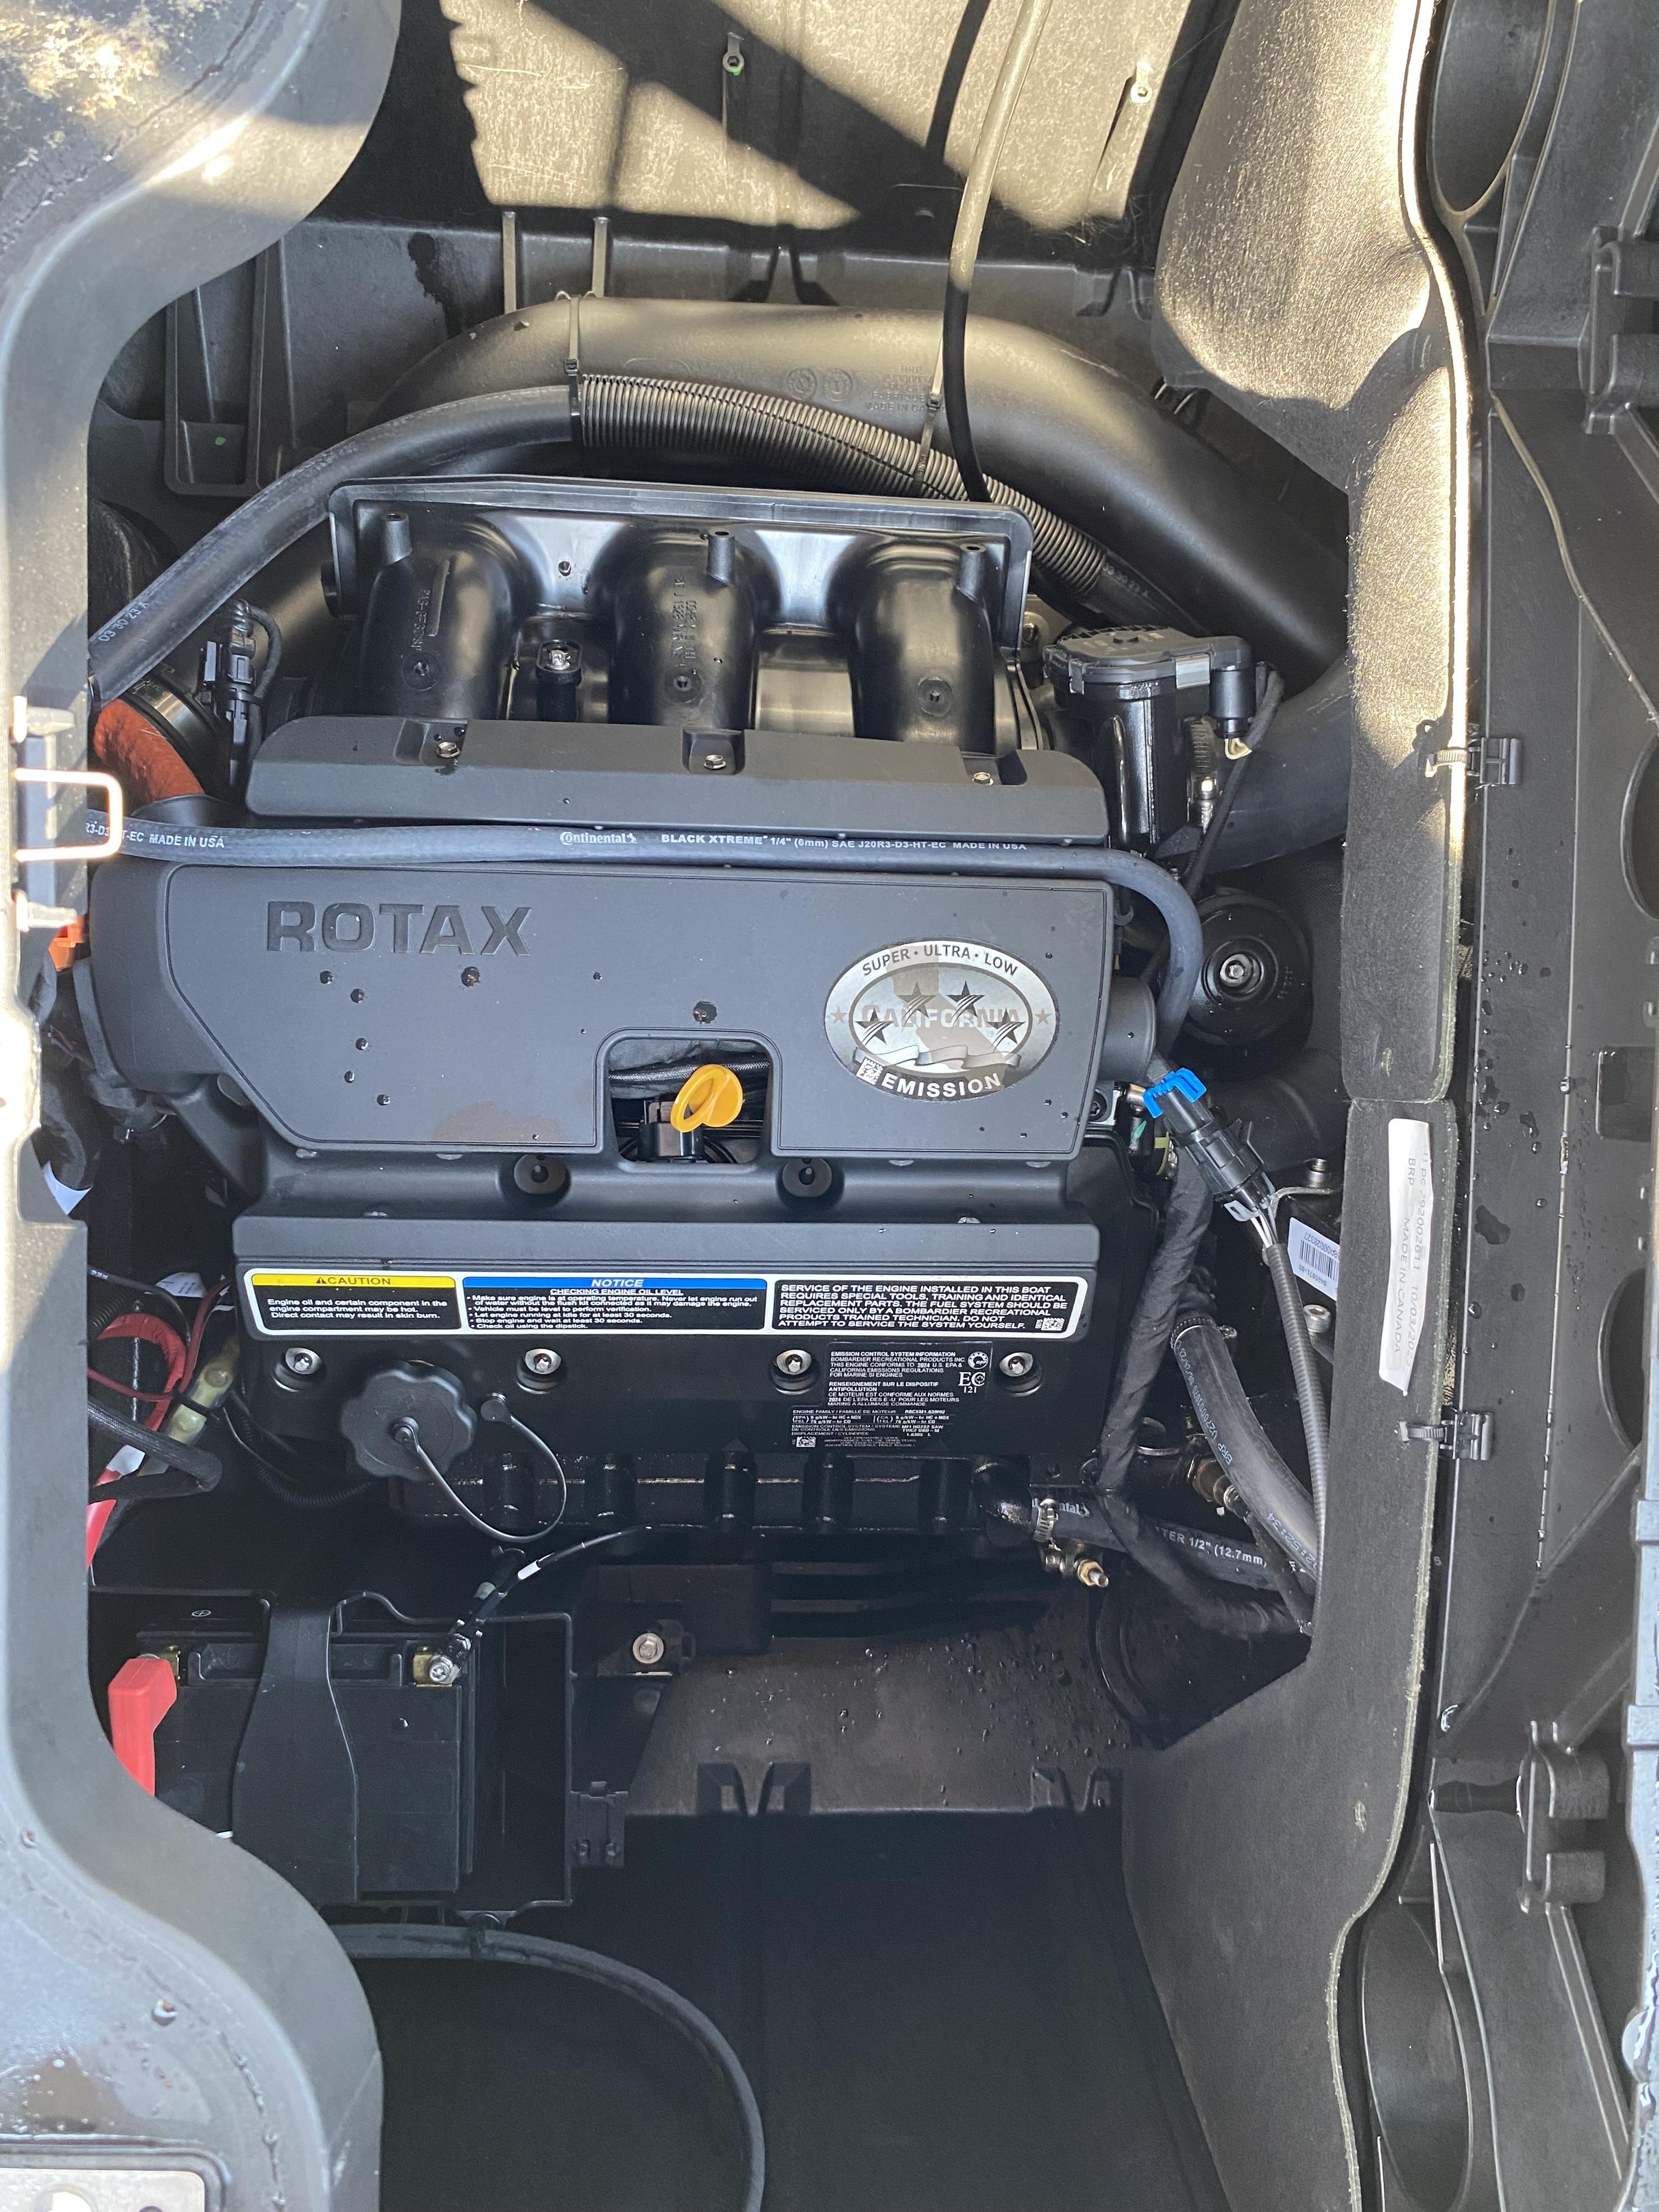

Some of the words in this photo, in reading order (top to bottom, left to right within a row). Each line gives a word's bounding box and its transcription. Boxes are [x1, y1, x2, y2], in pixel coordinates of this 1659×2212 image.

[149, 833, 182, 846] MADE
[184, 836, 196, 847] IN
[199, 837, 225, 848] USA
[560, 832, 629, 845] Continental
[662, 833, 706, 845] BLACK
[794, 836, 828, 848] (6mm)
[832, 837, 855, 849] SAE
[953, 839, 985, 852] MADE
[989, 839, 999, 853] IN
[1003, 840, 1026, 853] USA
[267, 901, 532, 956] ROTAX
[863, 949, 910, 977] SUPER
[923, 944, 970, 959] ULTRA
[984, 953, 1018, 977] LOW
[861, 1004, 1019, 1028] CALIFORNIA
[881, 1073, 1001, 1098] EMISSION
[1408, 1158, 1416, 1186] BRP
[1401, 1217, 1410, 1265] MADE
[328, 1277, 391, 1285] CAUTION
[591, 1279, 644, 1288] NOTICE
[1400, 1267, 1406, 1284] IN
[995, 1286, 1019, 1294] THIS
[1395, 1288, 1404, 1352] CANADA
[958, 1372, 986, 1386] EC
